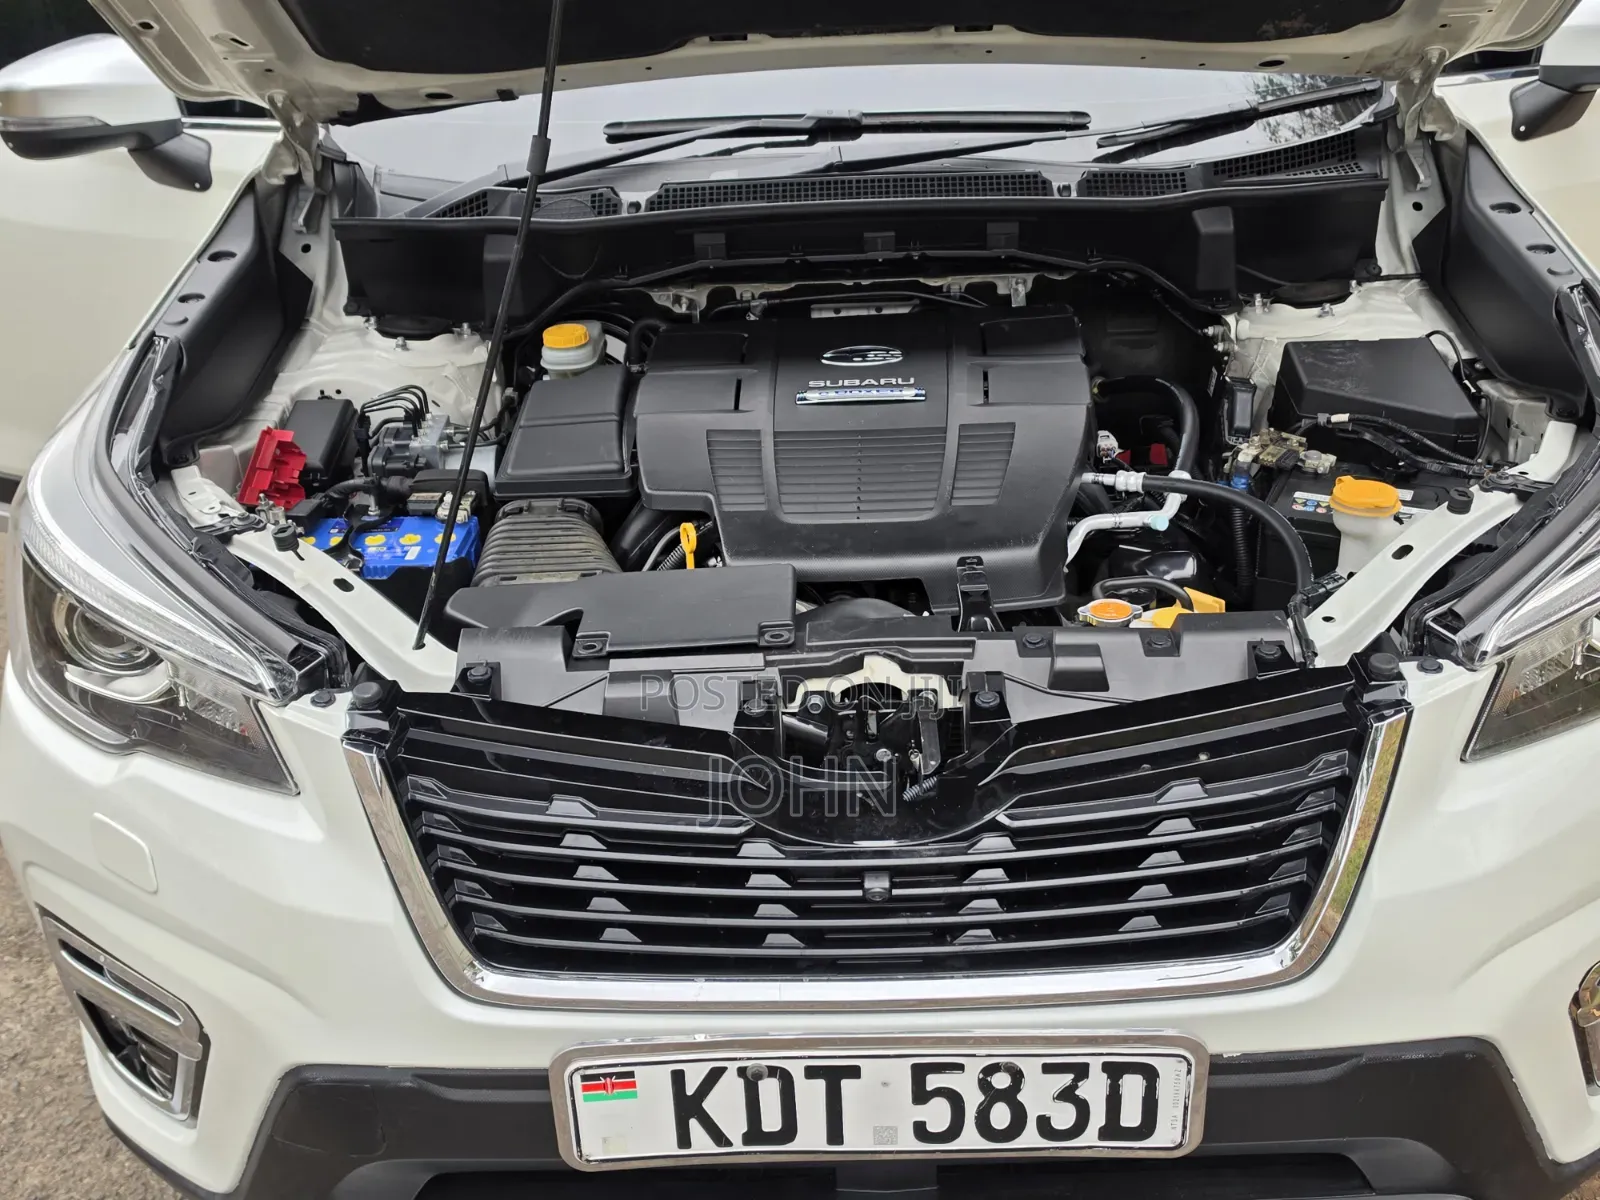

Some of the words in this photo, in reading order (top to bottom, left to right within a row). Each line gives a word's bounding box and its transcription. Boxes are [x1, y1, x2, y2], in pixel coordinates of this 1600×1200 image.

[808, 377, 915, 388] SUBARU
[670, 1065, 861, 1149] KDT
[910, 1061, 1160, 1144] 583D
